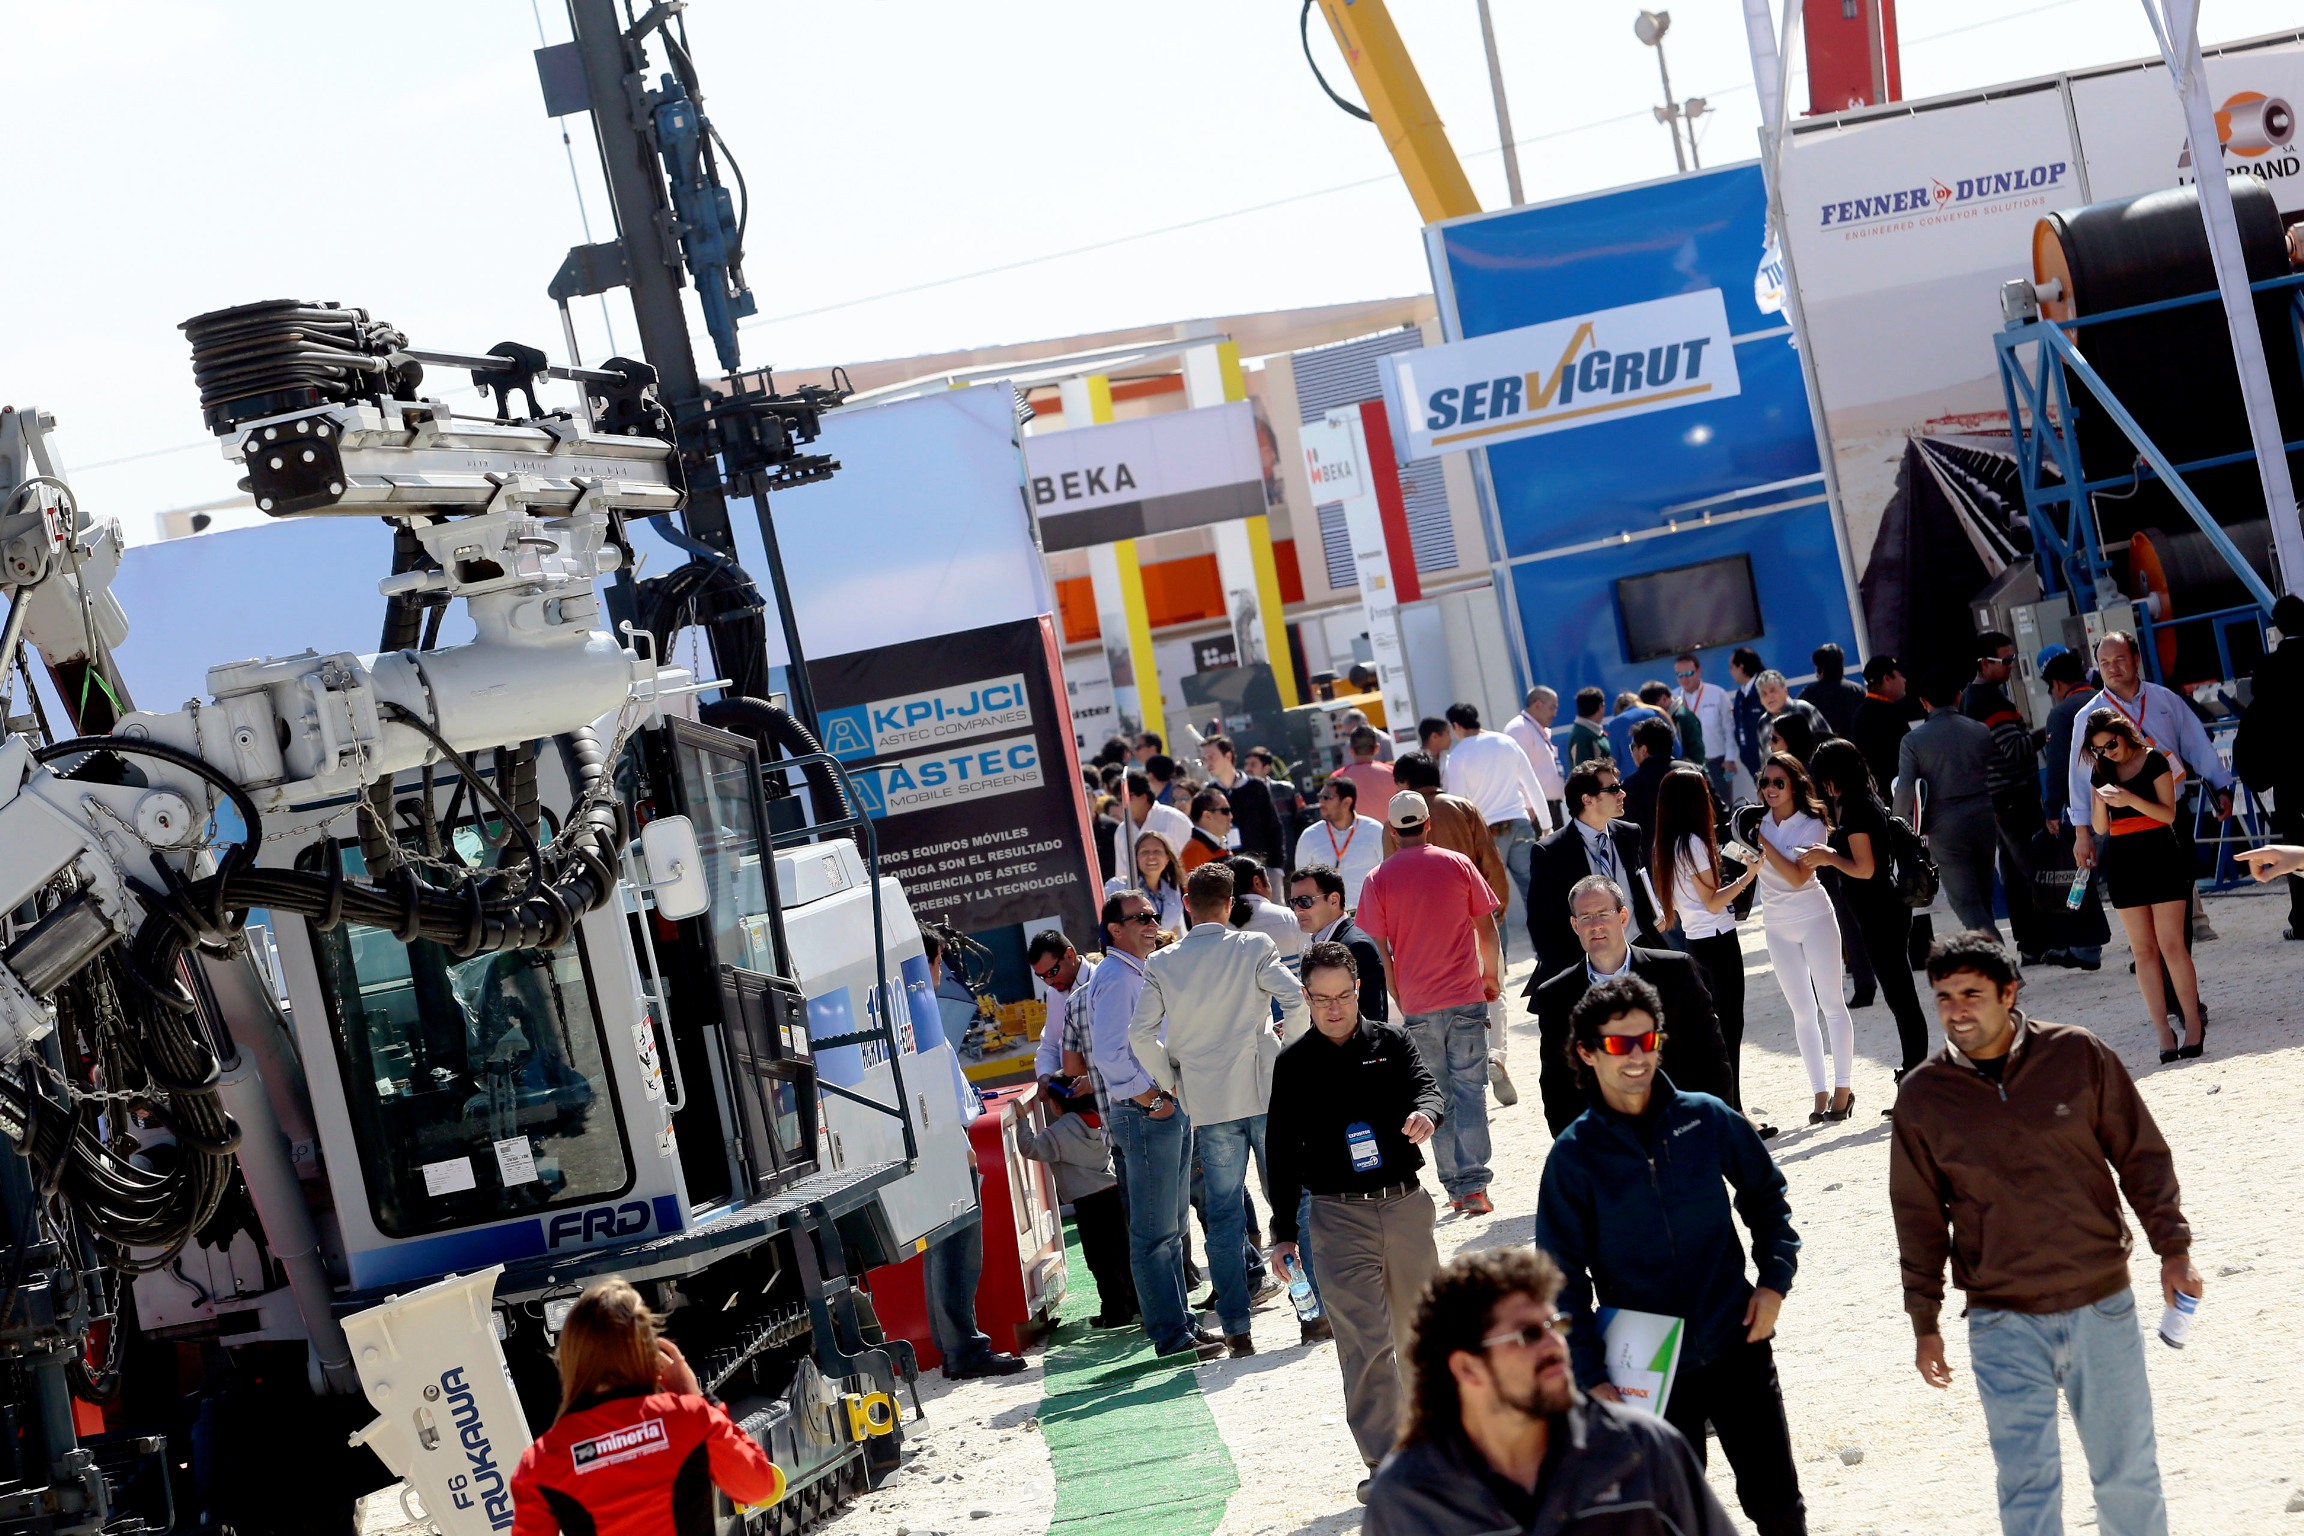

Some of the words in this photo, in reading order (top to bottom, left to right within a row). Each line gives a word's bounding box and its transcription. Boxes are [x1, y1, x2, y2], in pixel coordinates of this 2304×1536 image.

[1820, 188, 1930, 226] FENNER
[1955, 162, 2066, 201] DUNLOP
[1845, 222, 1914, 241] ENGINEERED
[1919, 209, 1978, 228] CONVEYOR
[1983, 196, 2046, 216] SOLUTIONS
[1427, 322, 1711, 431] SERVIGRUT
[1032, 462, 1137, 506] BEKA
[1322, 460, 1353, 483] BEKA
[872, 682, 1024, 734] KPI-JCI
[878, 727, 931, 748] ASTEC
[934, 710, 1027, 736] COMPANIES
[886, 744, 1037, 795] ASTEC
[889, 787, 953, 808] MOBILE
[957, 771, 1038, 795] SCREENS
[889, 863, 936, 879] ORUGA
[938, 857, 966, 872] SON
[969, 855, 986, 868] EL
[988, 839, 1063, 862] RESULTADO
[912, 839, 969, 859] EQUIPOS
[972, 827, 1029, 848] MÓVILES
[963, 892, 976, 903] Y
[976, 888, 993, 900] LA
[994, 872, 1078, 897] TECNOLOGÍA
[975, 870, 993, 883] DE
[996, 861, 1038, 880] ASTEC
[549, 1200, 650, 1249] FRD
[595, 1421, 660, 1455] minería
[447, 1474, 475, 1511] F6
